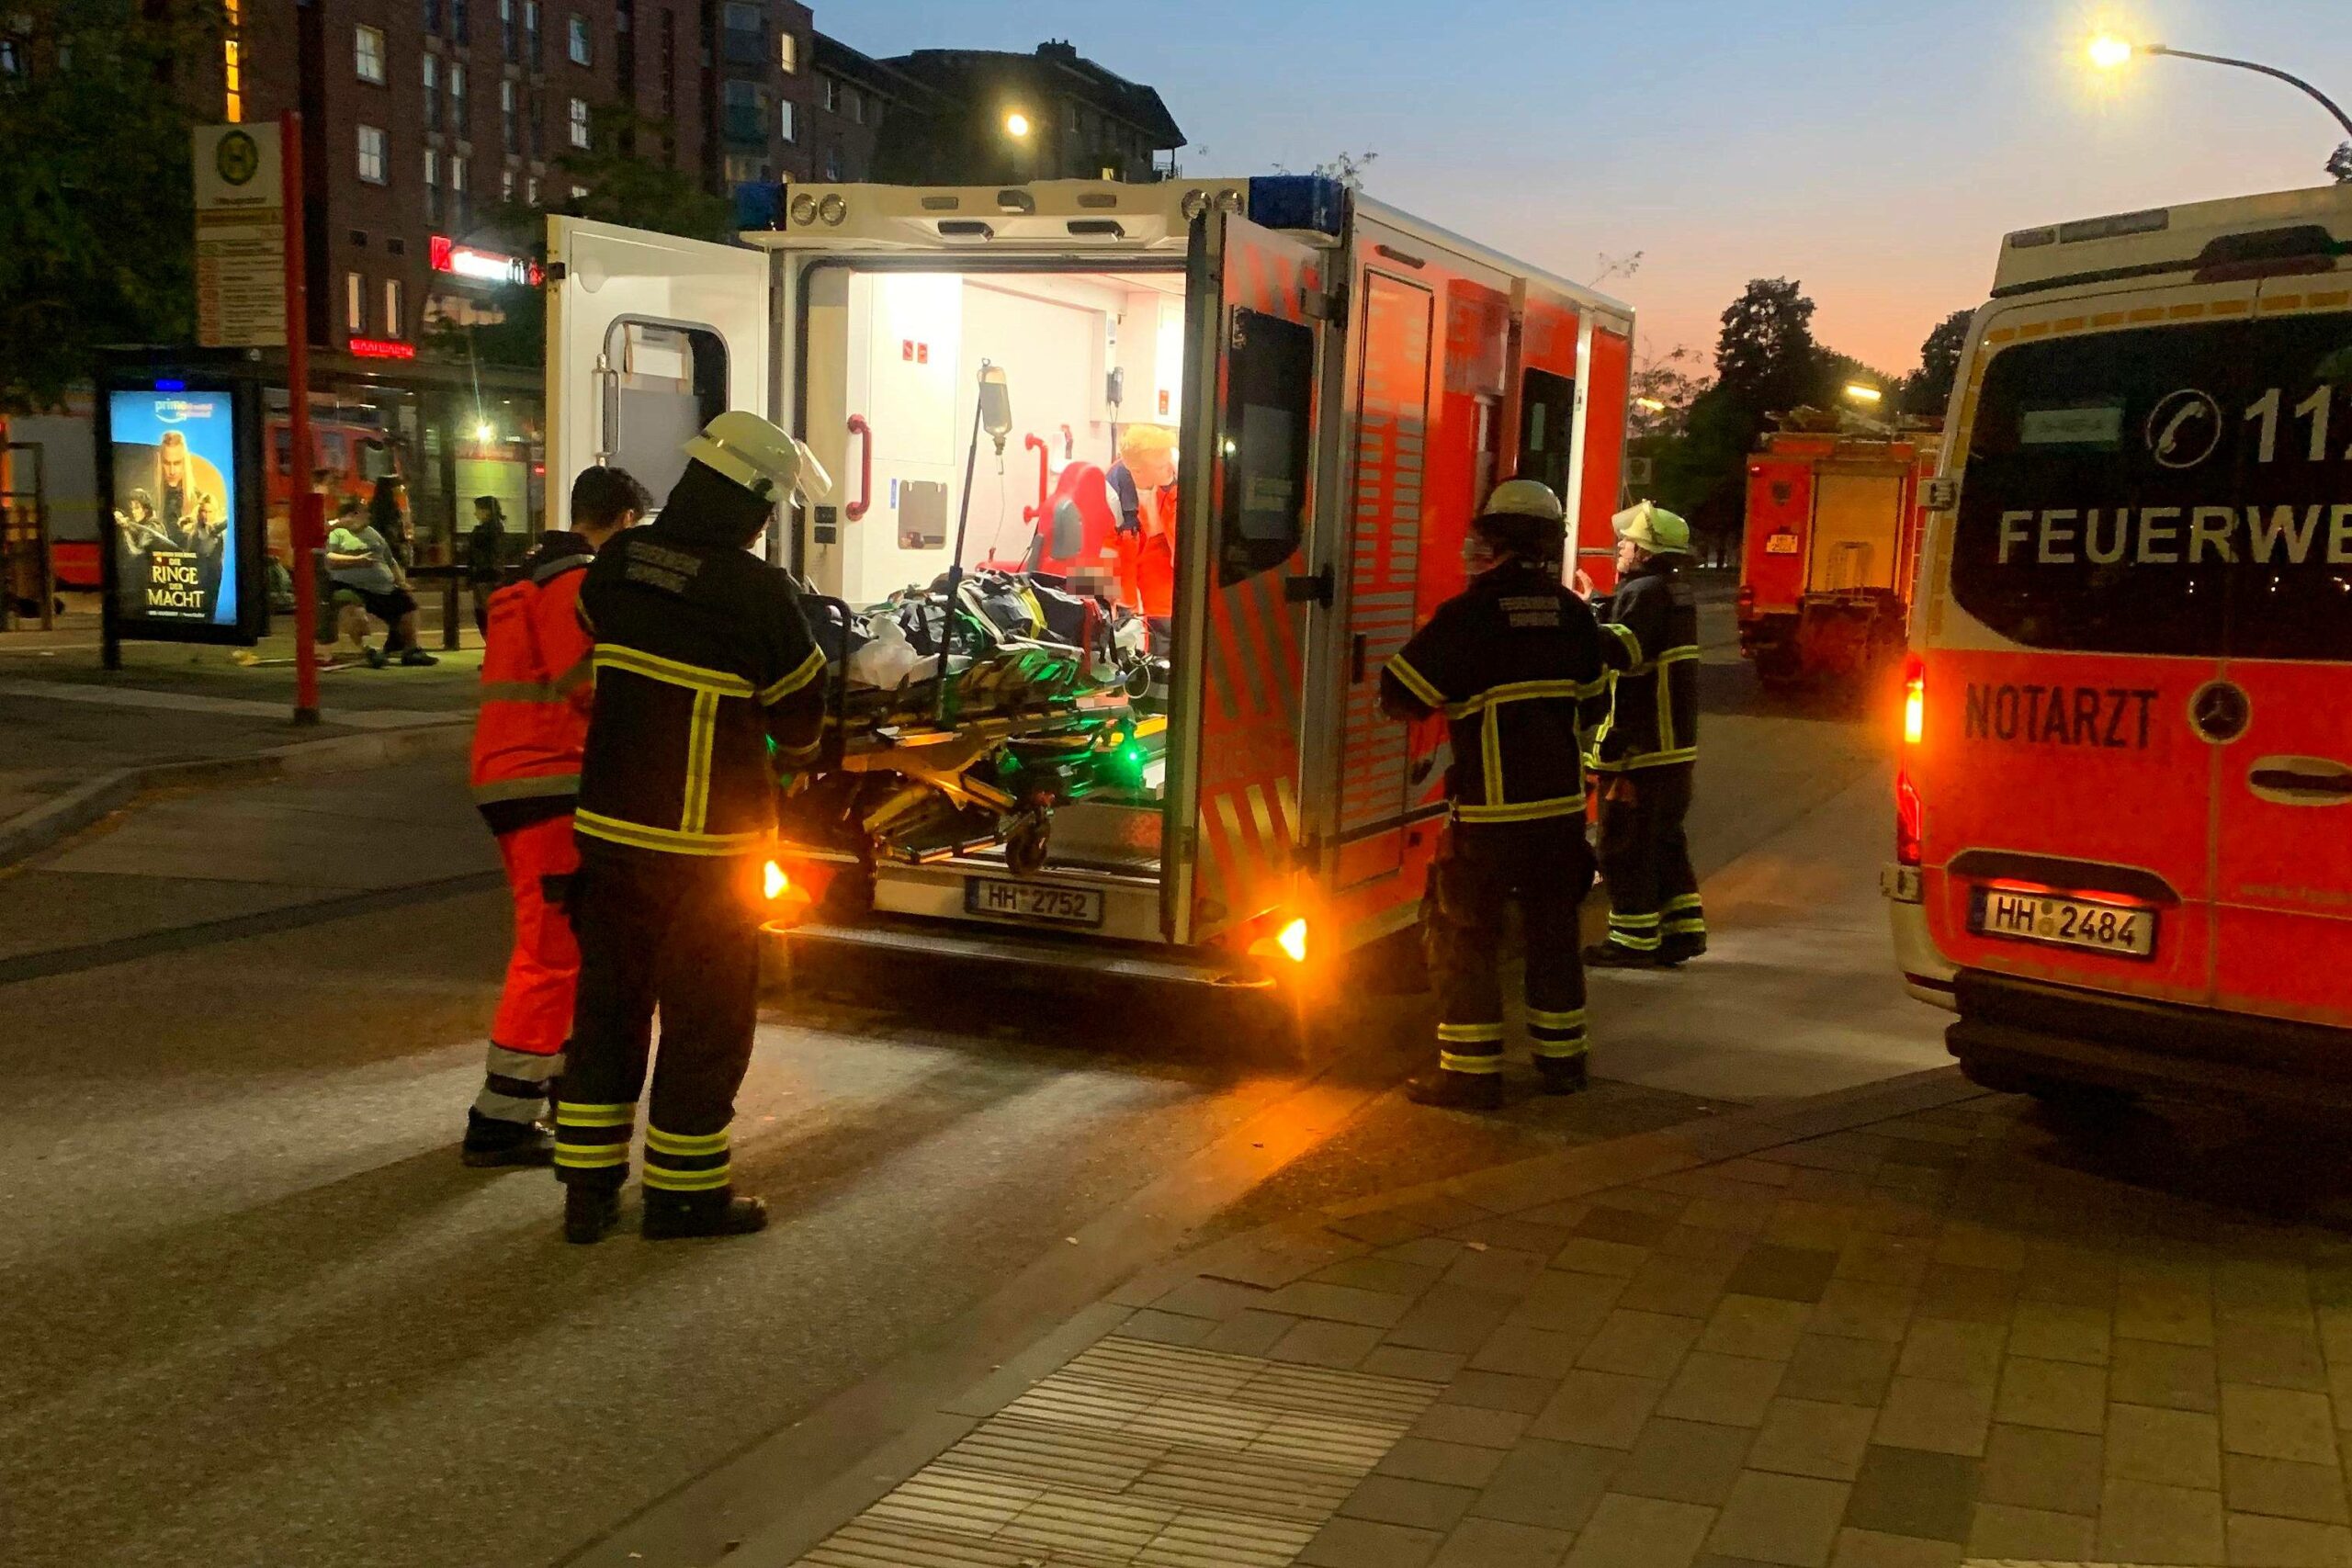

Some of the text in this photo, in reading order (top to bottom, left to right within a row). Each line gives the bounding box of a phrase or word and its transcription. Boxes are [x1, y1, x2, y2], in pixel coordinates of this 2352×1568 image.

[2244, 385, 2352, 462] 11
[1998, 504, 2352, 564] FEUERWE
[147, 588, 205, 608] MACHT
[152, 566, 198, 584] RINGE
[1965, 682, 2157, 750] NOTARZT
[989, 884, 1088, 918] HH 2752
[1996, 895, 2137, 946] HH 2484
